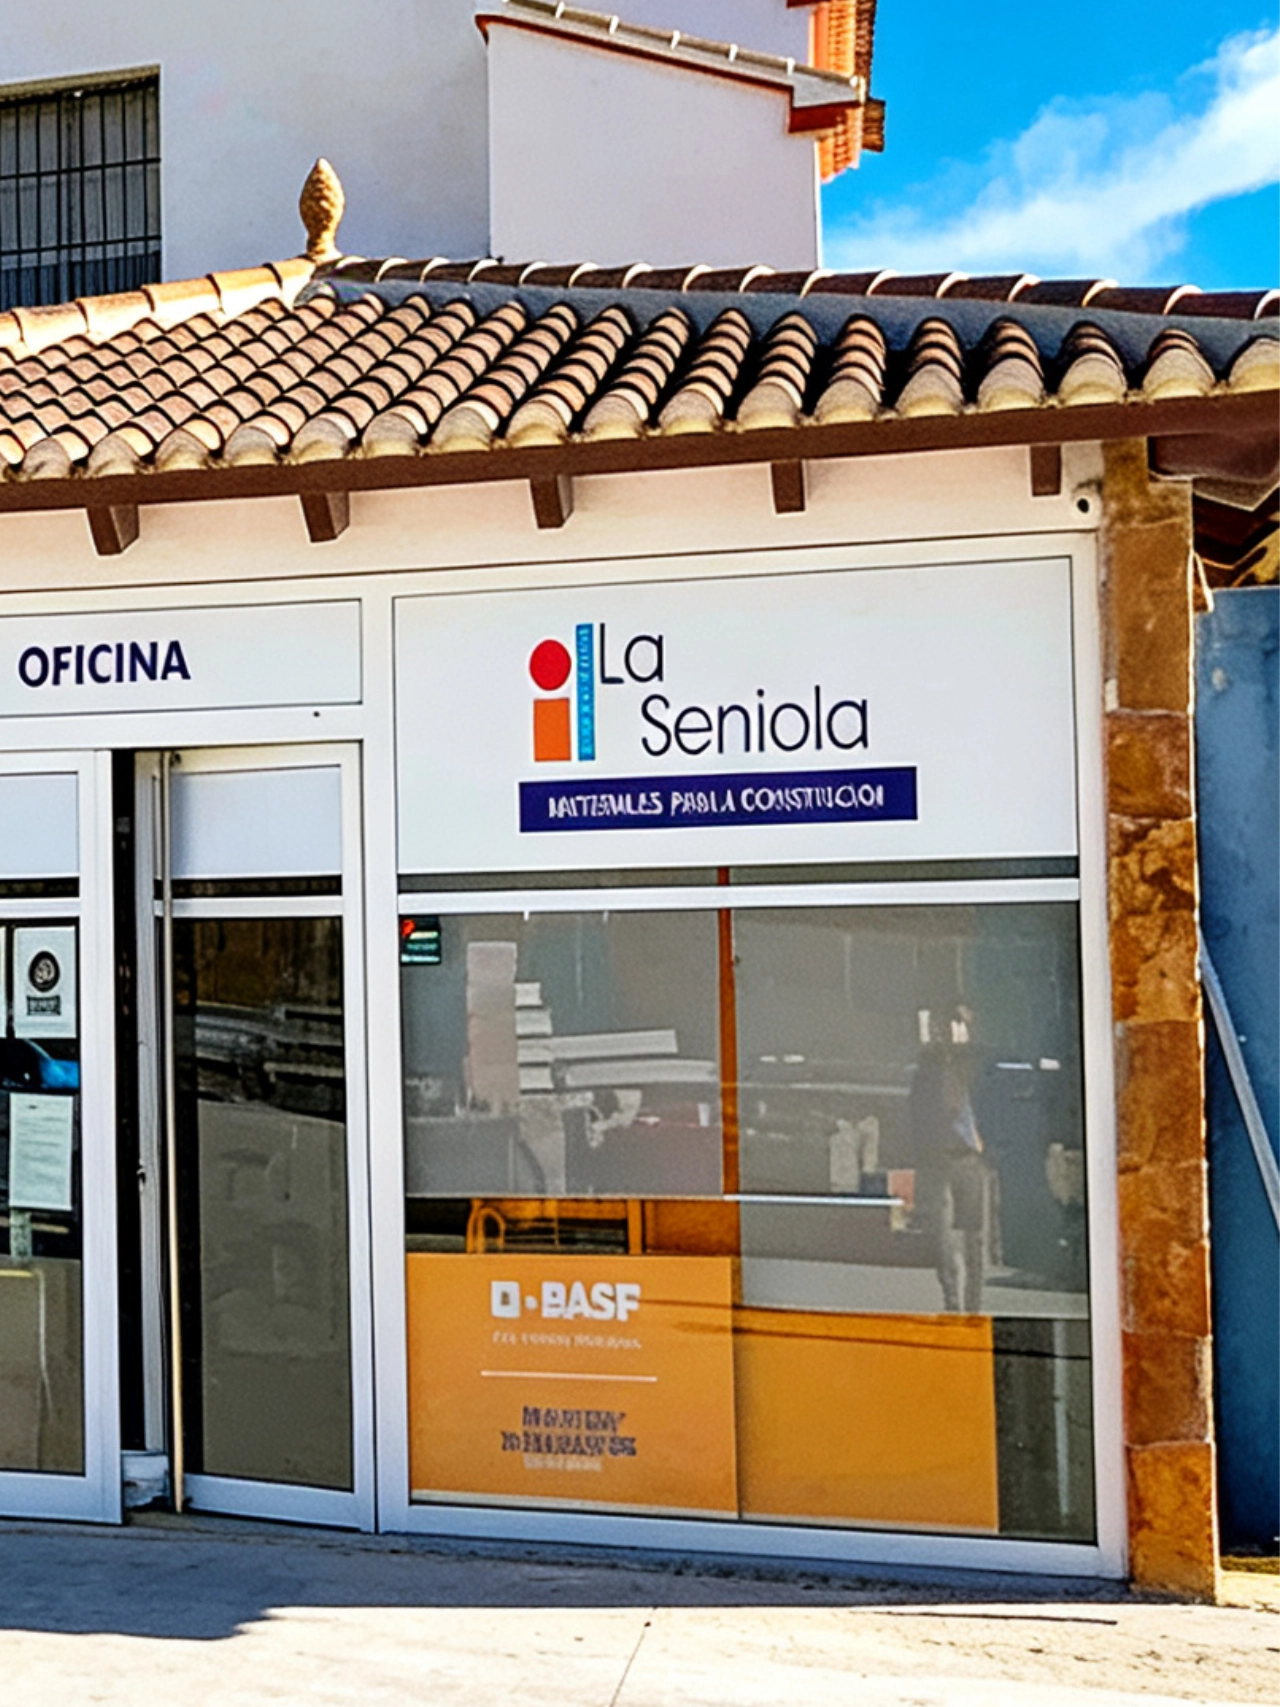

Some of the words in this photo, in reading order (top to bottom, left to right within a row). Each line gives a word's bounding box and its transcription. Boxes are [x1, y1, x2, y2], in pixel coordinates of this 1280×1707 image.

[18, 640, 192, 688] OFICINA
[599, 622, 663, 684] La
[641, 685, 869, 756] Seniola
